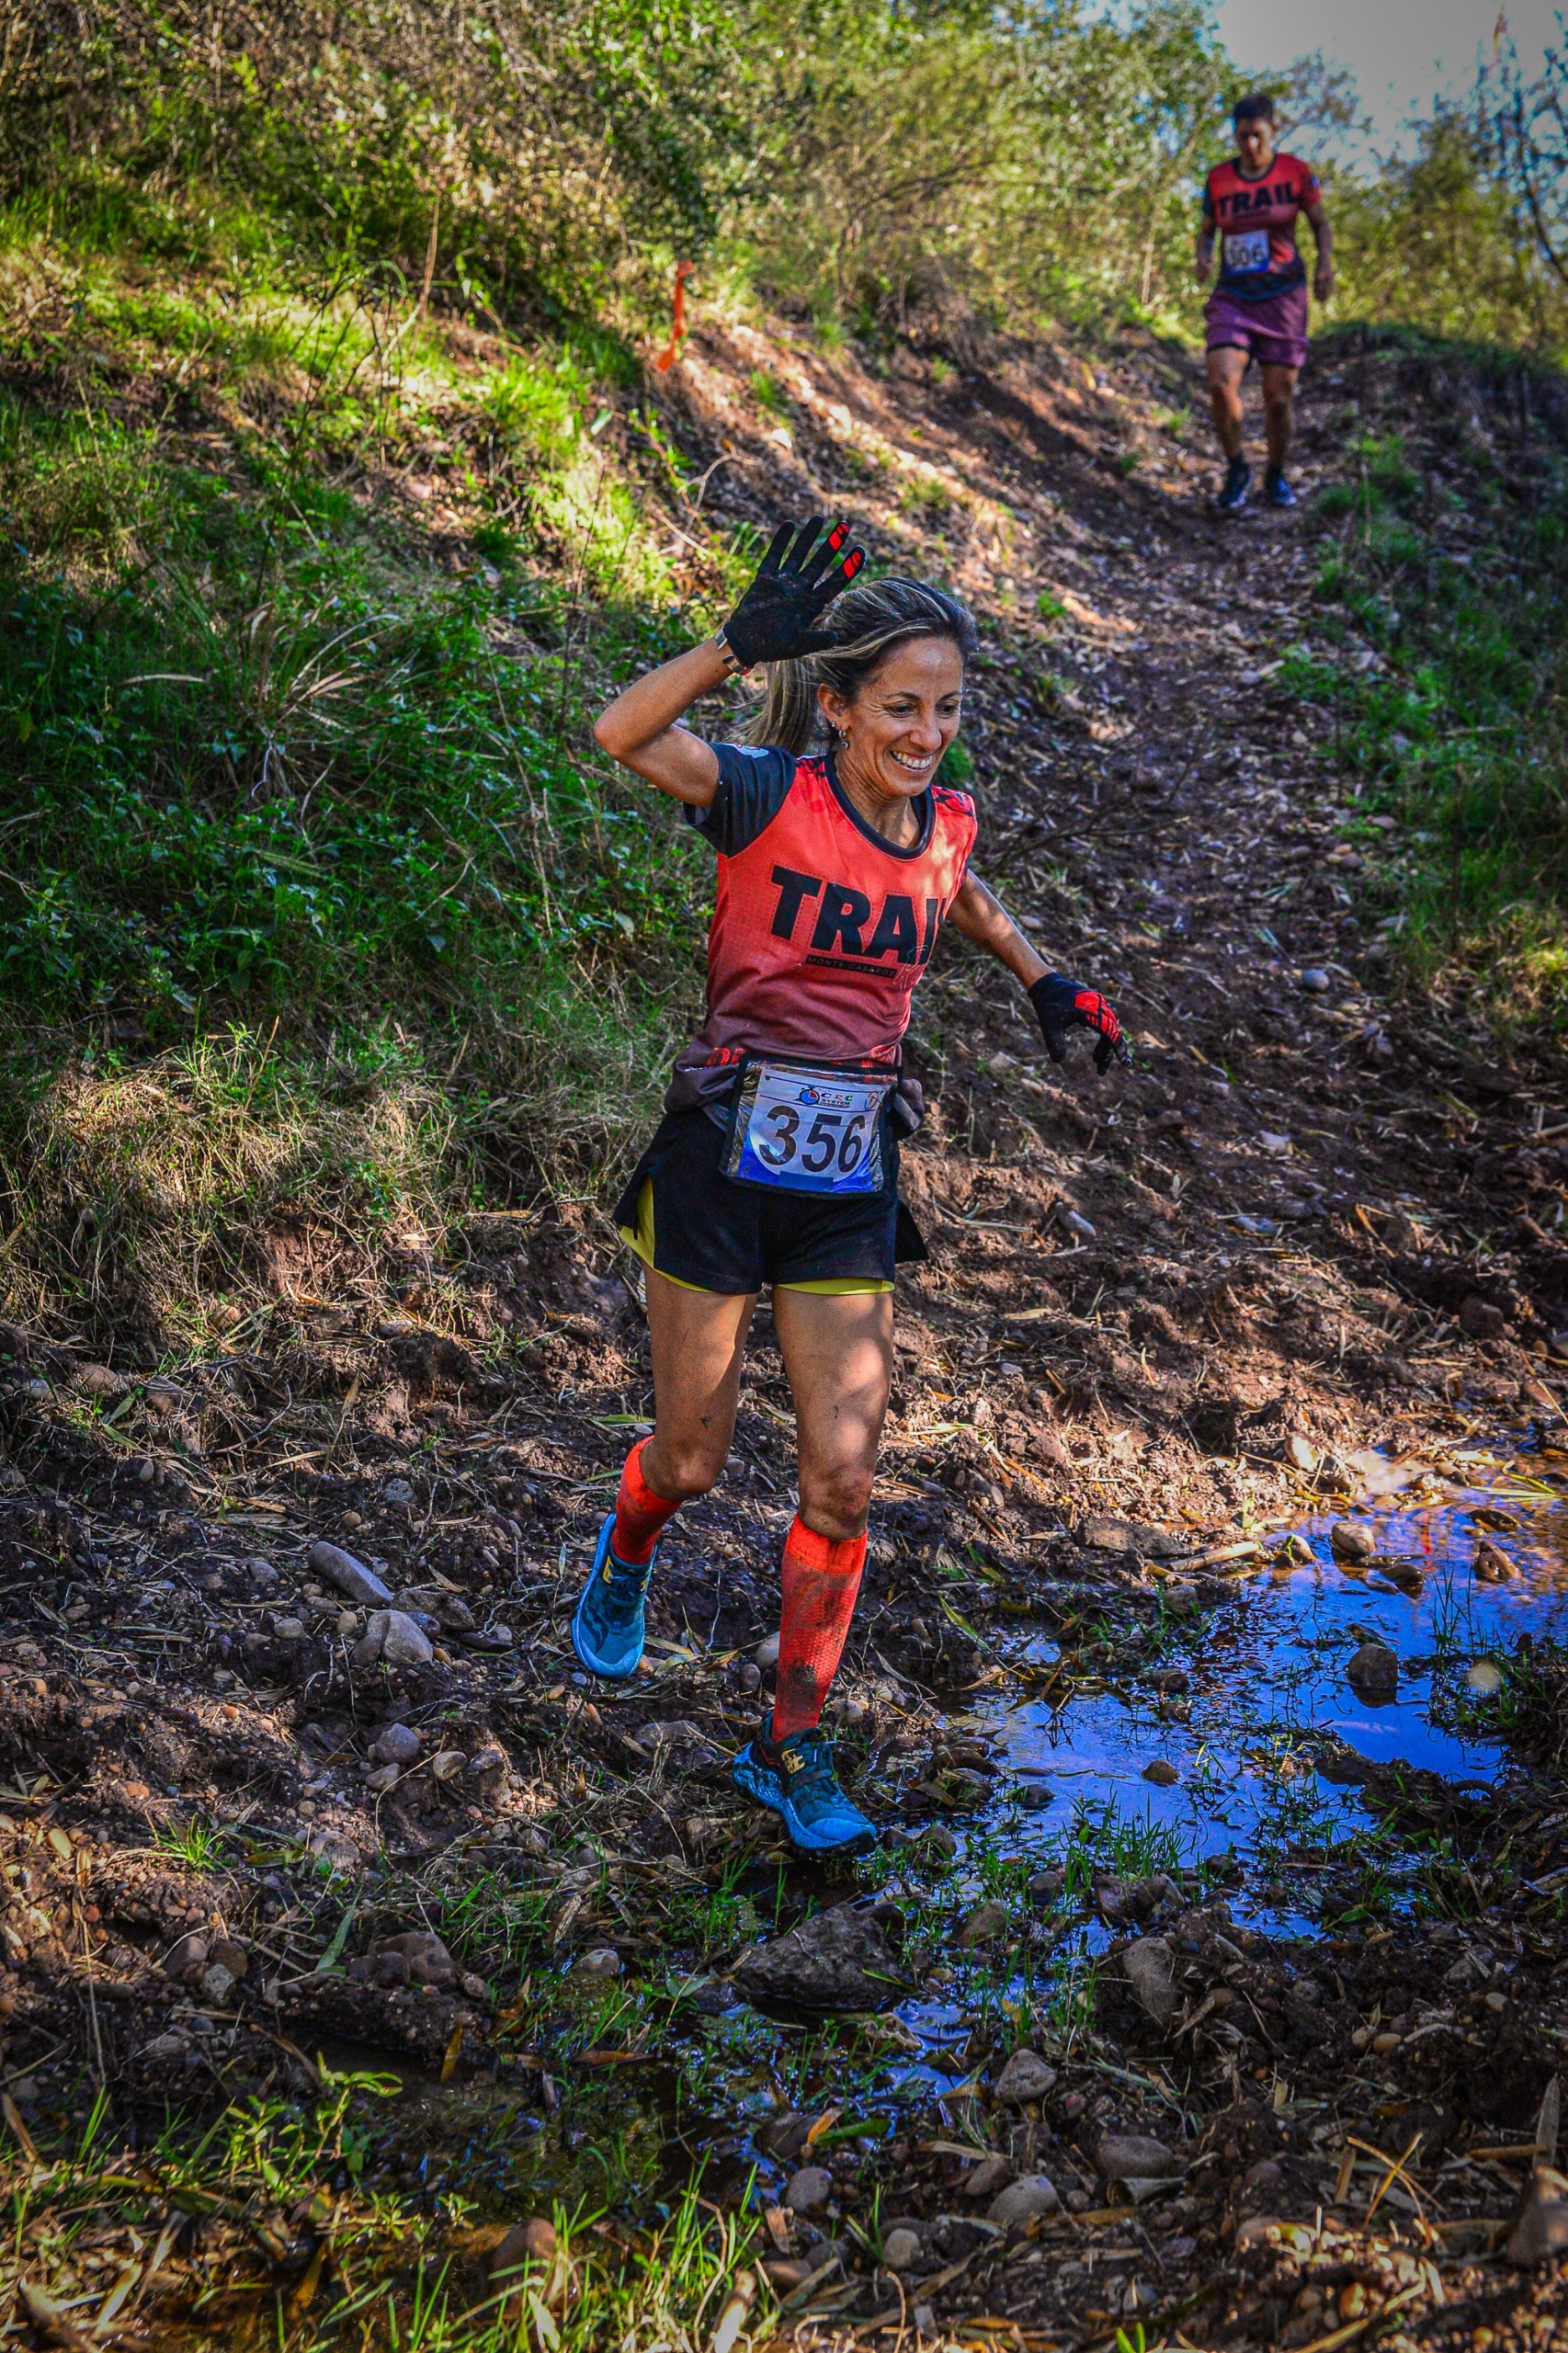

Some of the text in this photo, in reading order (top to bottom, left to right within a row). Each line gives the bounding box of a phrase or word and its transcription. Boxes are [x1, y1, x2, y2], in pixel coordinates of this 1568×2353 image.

[1218, 181, 1298, 217] TRAIL
[808, 956, 896, 977] MONTE CASEROS
[758, 1105, 866, 1174] 356
